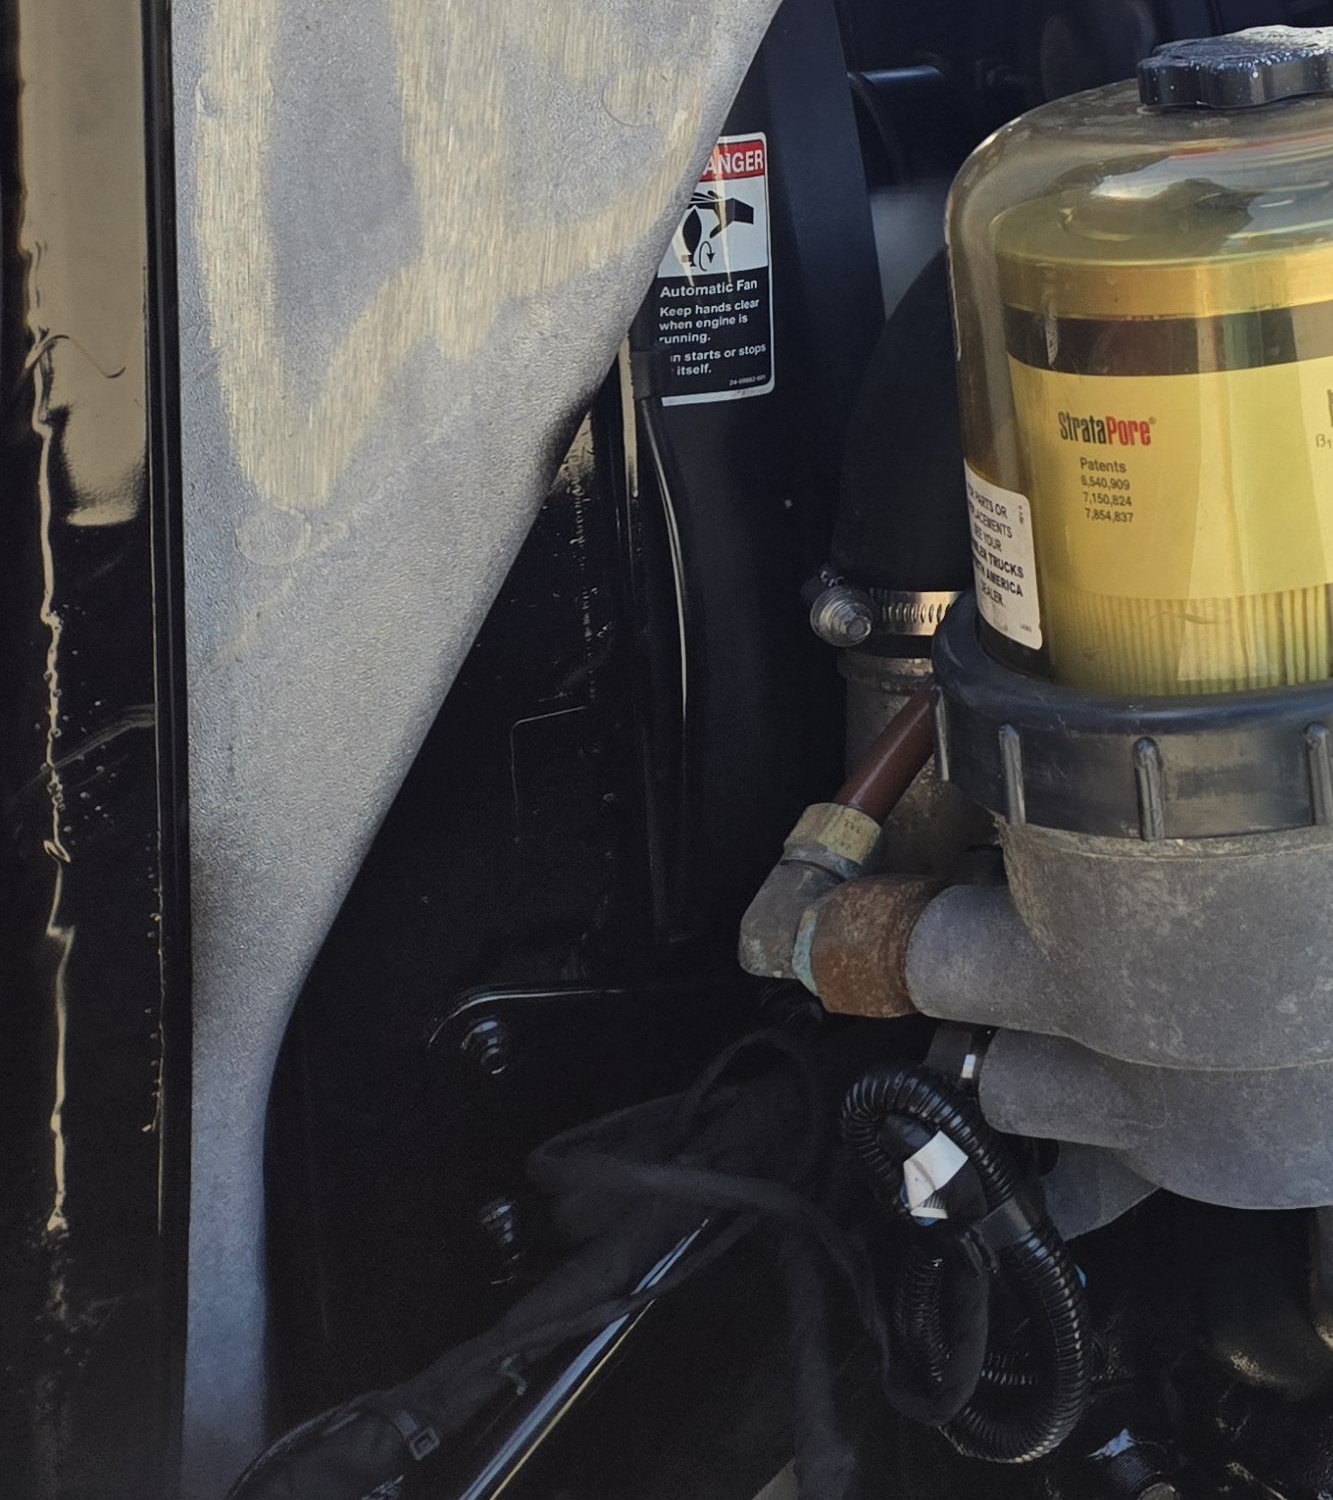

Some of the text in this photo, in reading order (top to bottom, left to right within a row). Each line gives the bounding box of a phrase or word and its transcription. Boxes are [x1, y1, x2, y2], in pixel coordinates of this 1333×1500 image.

[702, 149, 764, 175] ANGER
[660, 279, 758, 299] Automatic Fan
[660, 297, 760, 318] Keep hands clear
[659, 313, 748, 332] when engine is
[659, 332, 711, 345] running.
[684, 350, 721, 362] starts
[724, 347, 736, 359] or
[738, 343, 767, 358] stops
[676, 363, 712, 376] itself.
[1080, 457, 1127, 474] Patents
[1081, 475, 1131, 491] 6,540,909
[975, 490, 994, 514] PARTS
[995, 503, 1008, 520] OR
[1083, 491, 1132, 507] 7,150,824
[968, 501, 1013, 539] PLACEMENTS
[1085, 507, 1134, 524] 7,854,837
[983, 530, 1002, 552] YOUR
[988, 552, 1024, 579] TRUCKS
[986, 570, 1024, 597] AMERICA
